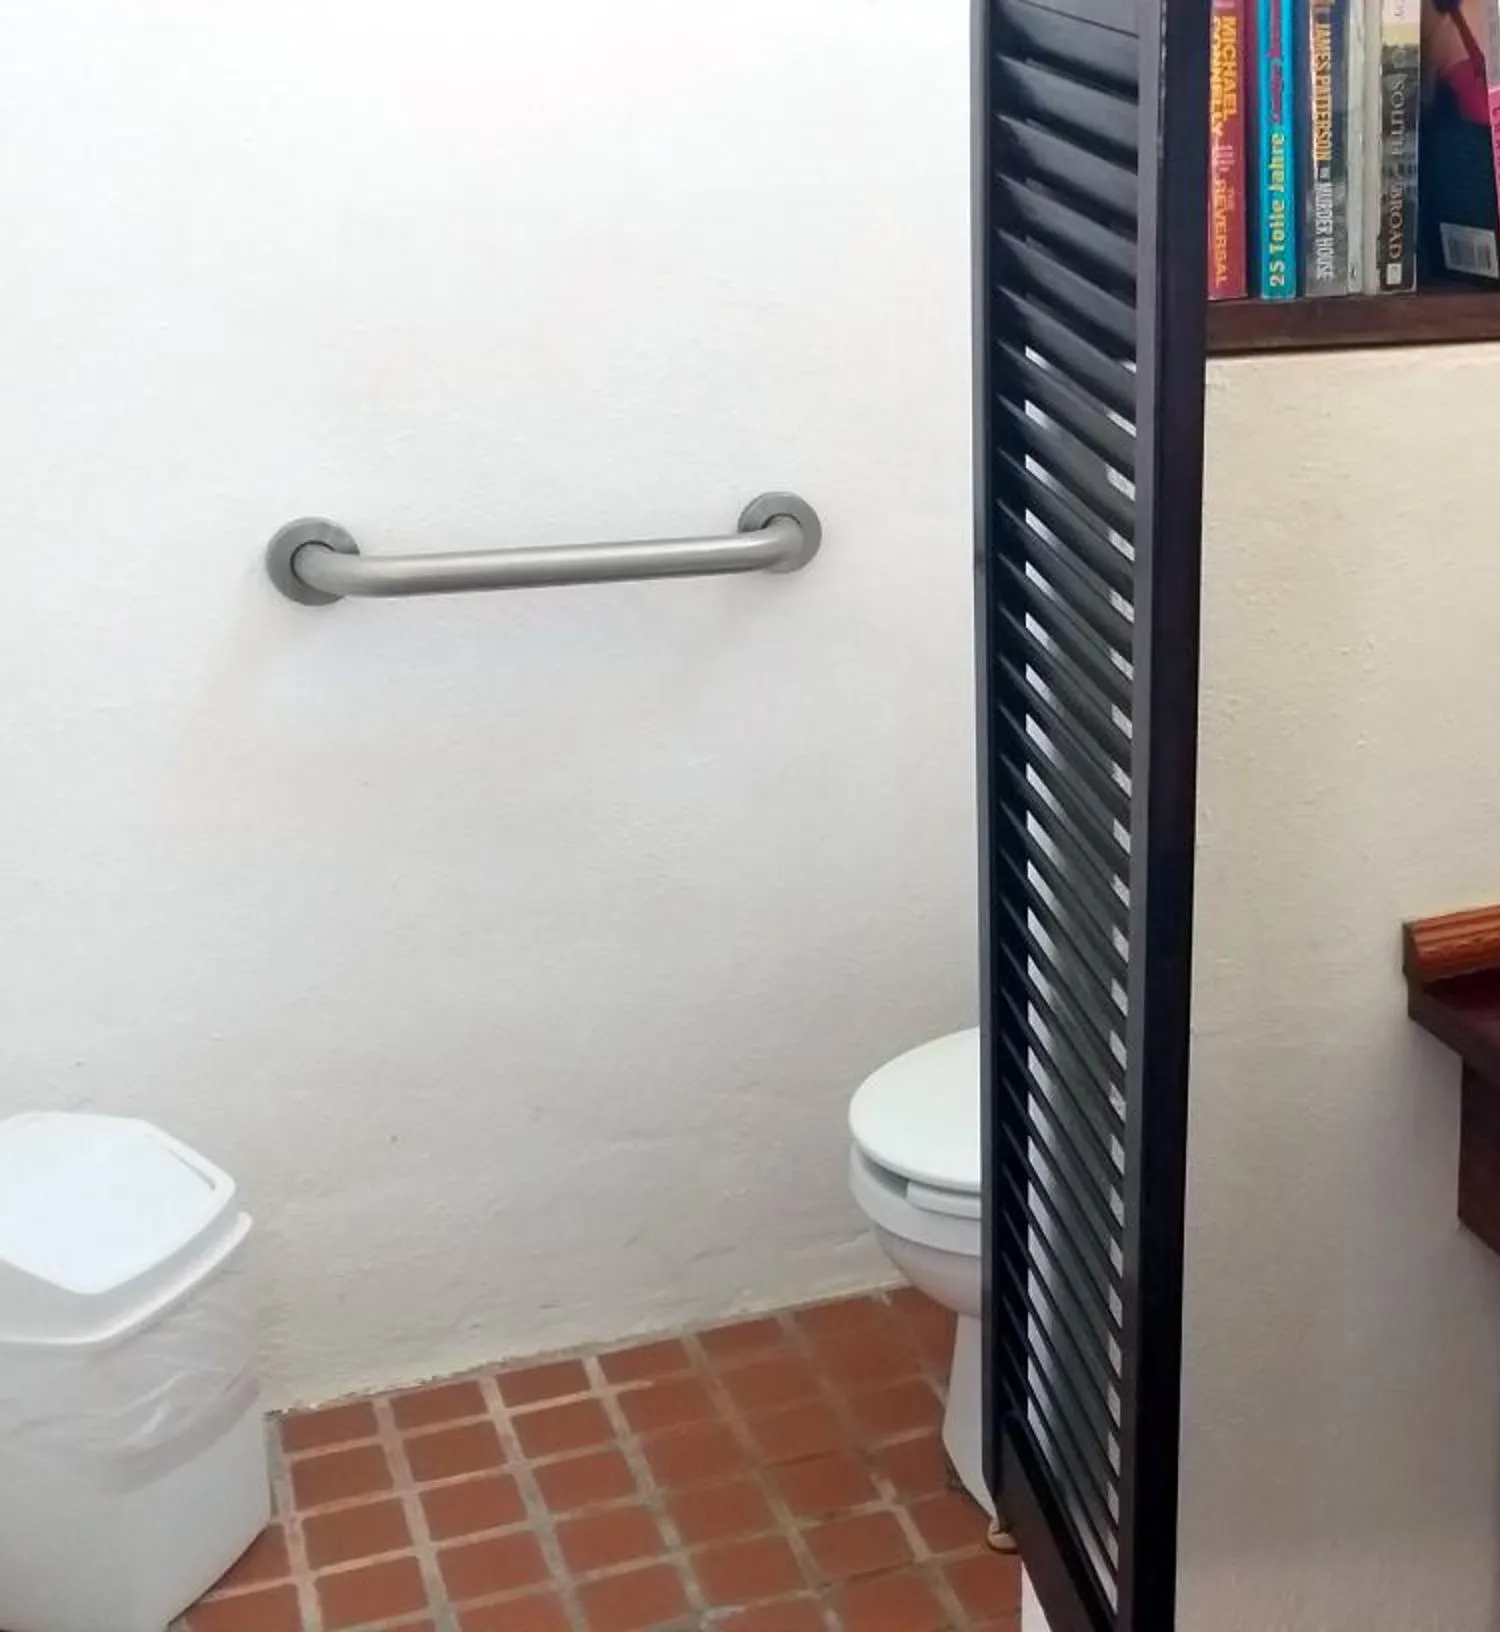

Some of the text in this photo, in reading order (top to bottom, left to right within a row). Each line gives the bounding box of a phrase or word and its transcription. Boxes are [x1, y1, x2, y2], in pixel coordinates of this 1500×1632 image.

[1222, 15, 1238, 121] MICHAEL
[1313, 22, 1333, 73] JAMES
[1313, 74, 1333, 161] PATTERSON
[1267, 131, 1286, 194] Jahre
[1214, 178, 1228, 288] REVERSAL
[1268, 198, 1286, 255] Tolle
[1315, 182, 1333, 236] MURDER
[1386, 187, 1404, 260] BROAD
[1268, 260, 1286, 288] 25
[1316, 236, 1334, 281] HOUSE
